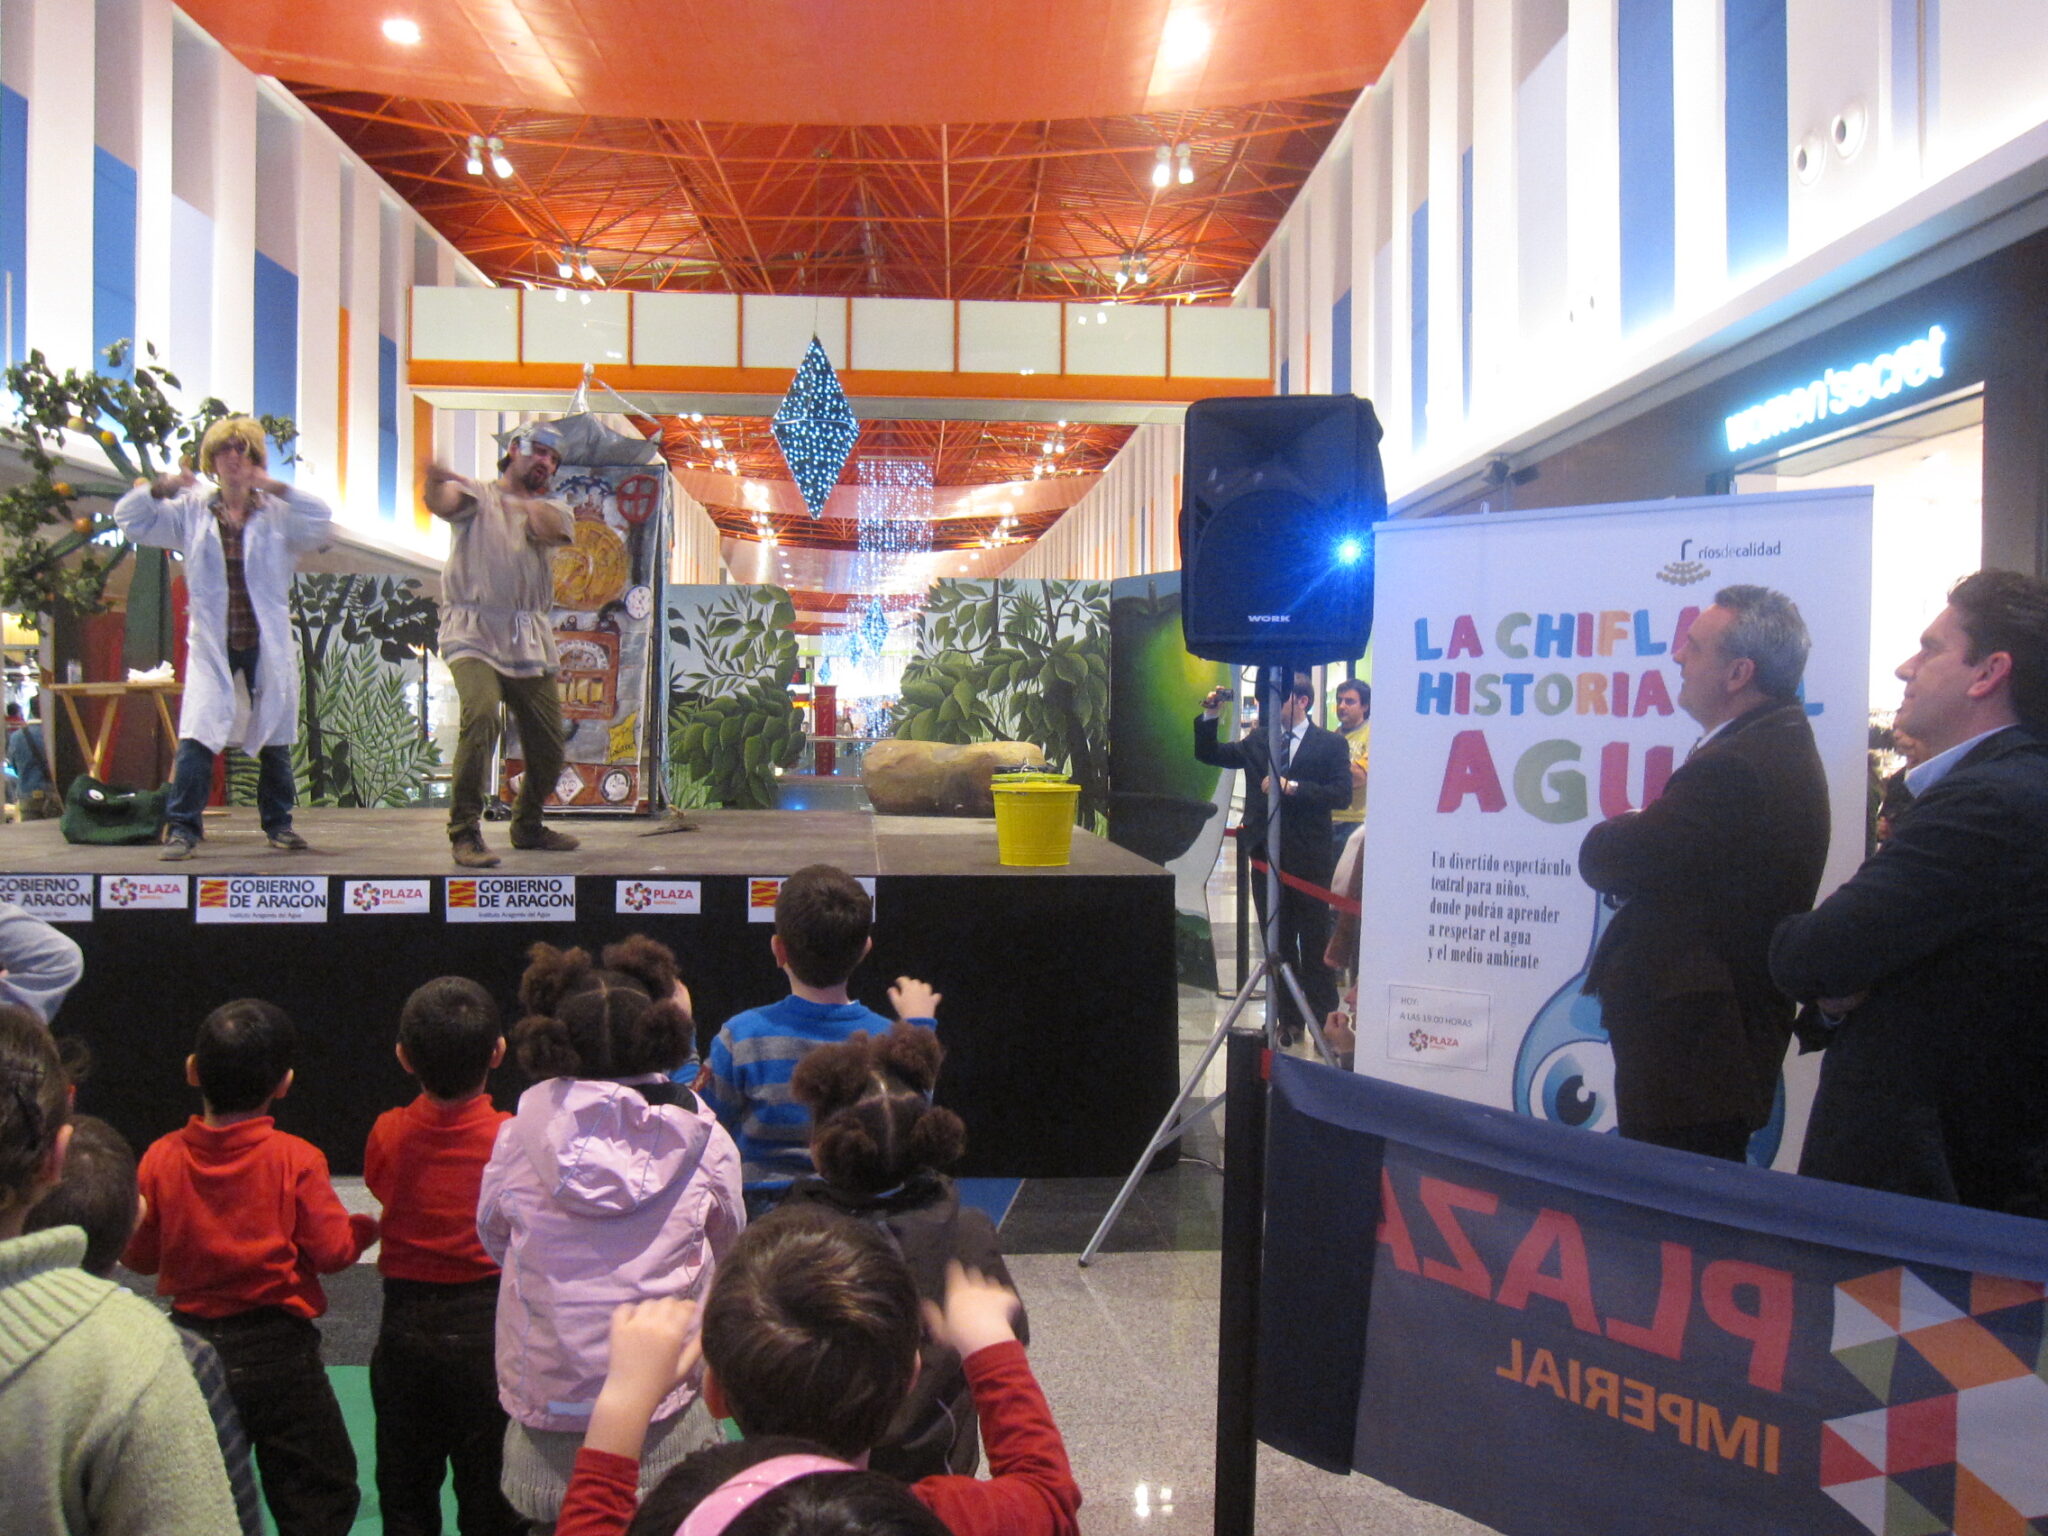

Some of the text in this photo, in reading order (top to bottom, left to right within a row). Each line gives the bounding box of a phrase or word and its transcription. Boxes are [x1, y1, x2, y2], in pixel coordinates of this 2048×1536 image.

[1414, 614, 1484, 661] LA
[1415, 670, 1674, 717] HISTORIA
[1436, 730, 1674, 825] AGU
[1432, 851, 1571, 877] Un divertido espectáculo
[139, 884, 181, 893] PLAZA
[230, 880, 315, 893] GOBIERNO
[478, 879, 562, 893] GOBIERNO
[1431, 876, 1530, 899] teatral para niños,
[21, 893, 91, 906] ARAGON
[382, 889, 423, 898] PLAZA
[479, 894, 574, 907] DE ARAGON
[653, 889, 693, 899] PLAZA
[229, 895, 326, 908] DE ARAGON
[1430, 897, 1560, 924] donde podrán aprender
[1429, 923, 1531, 948] a respetar el agua
[1428, 944, 1539, 970] y el medio ambiente
[1407, 1013, 1420, 1021] LAS
[1445, 1018, 1473, 1027] HORAS
[1429, 1035, 1459, 1047] PLAZA
